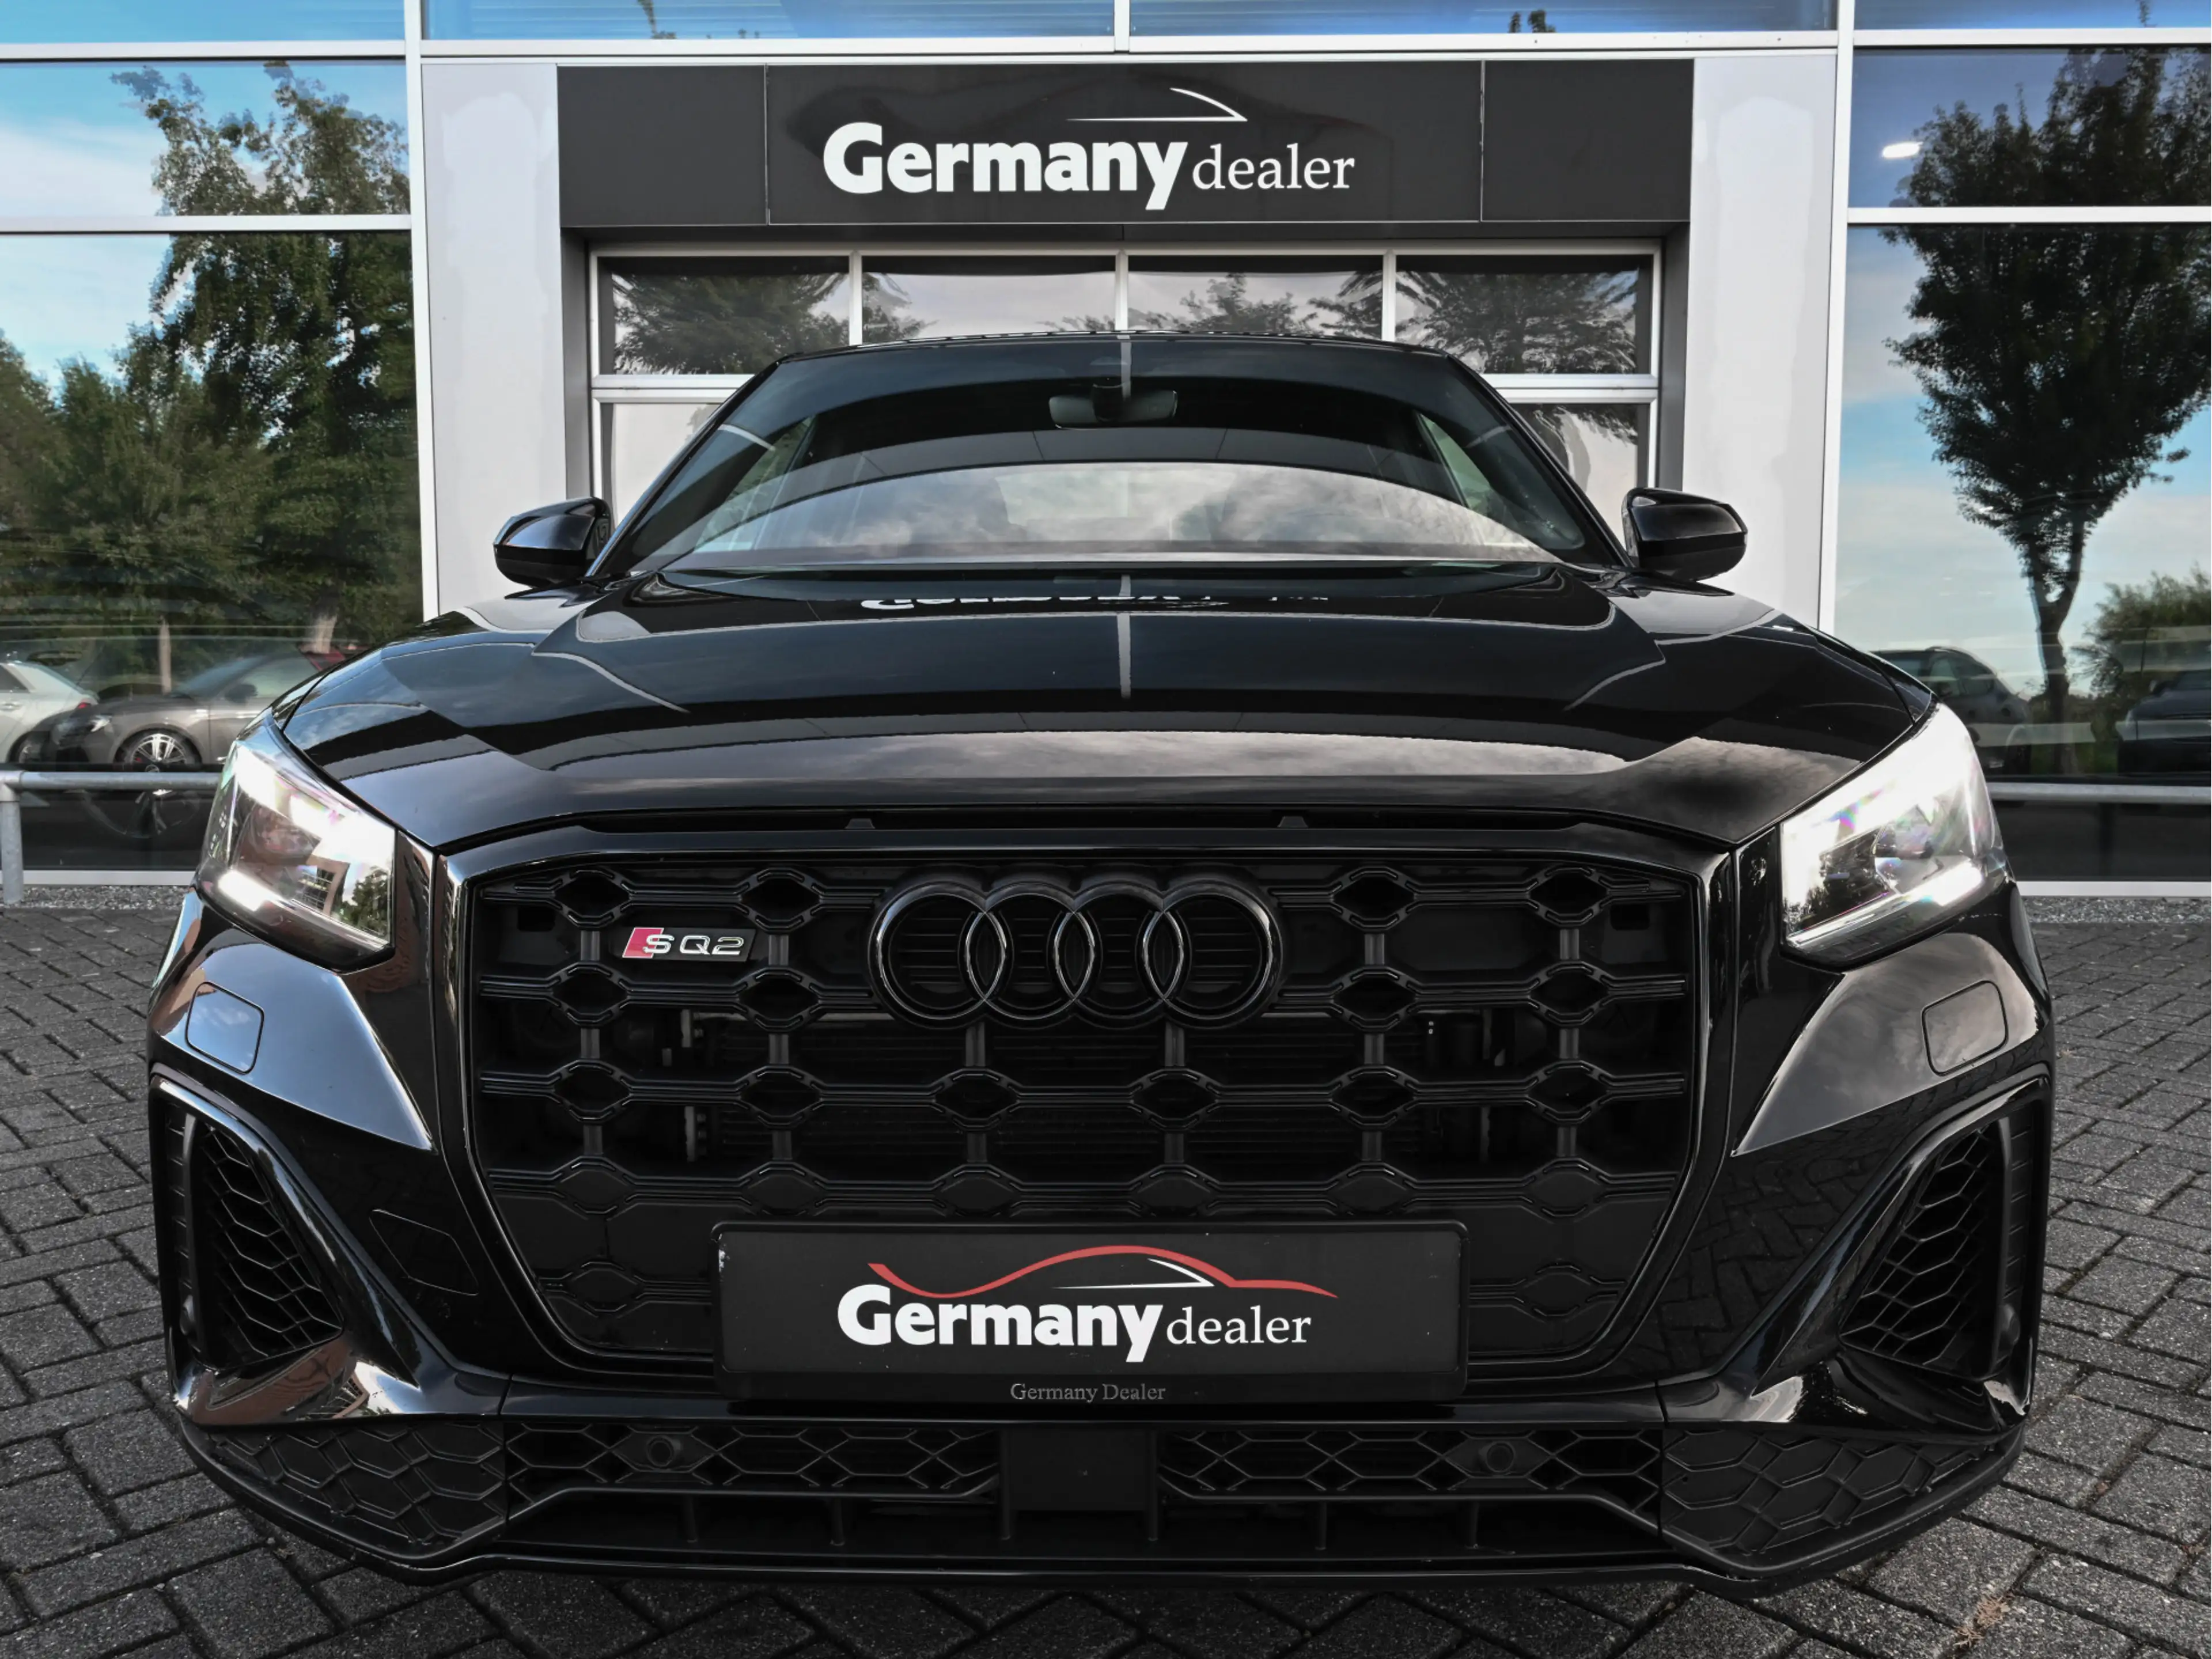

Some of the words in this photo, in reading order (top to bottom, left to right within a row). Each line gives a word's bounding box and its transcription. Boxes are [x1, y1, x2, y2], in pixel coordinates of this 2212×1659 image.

[823, 122, 1188, 211] Germany
[1192, 142, 1355, 190] dealer
[643, 934, 744, 956] SQ2
[837, 1284, 1164, 1363] Germany
[1166, 1305, 1312, 1344] dealer
[1010, 1383, 1098, 1403] Germany
[1102, 1383, 1166, 1400] Dealer
